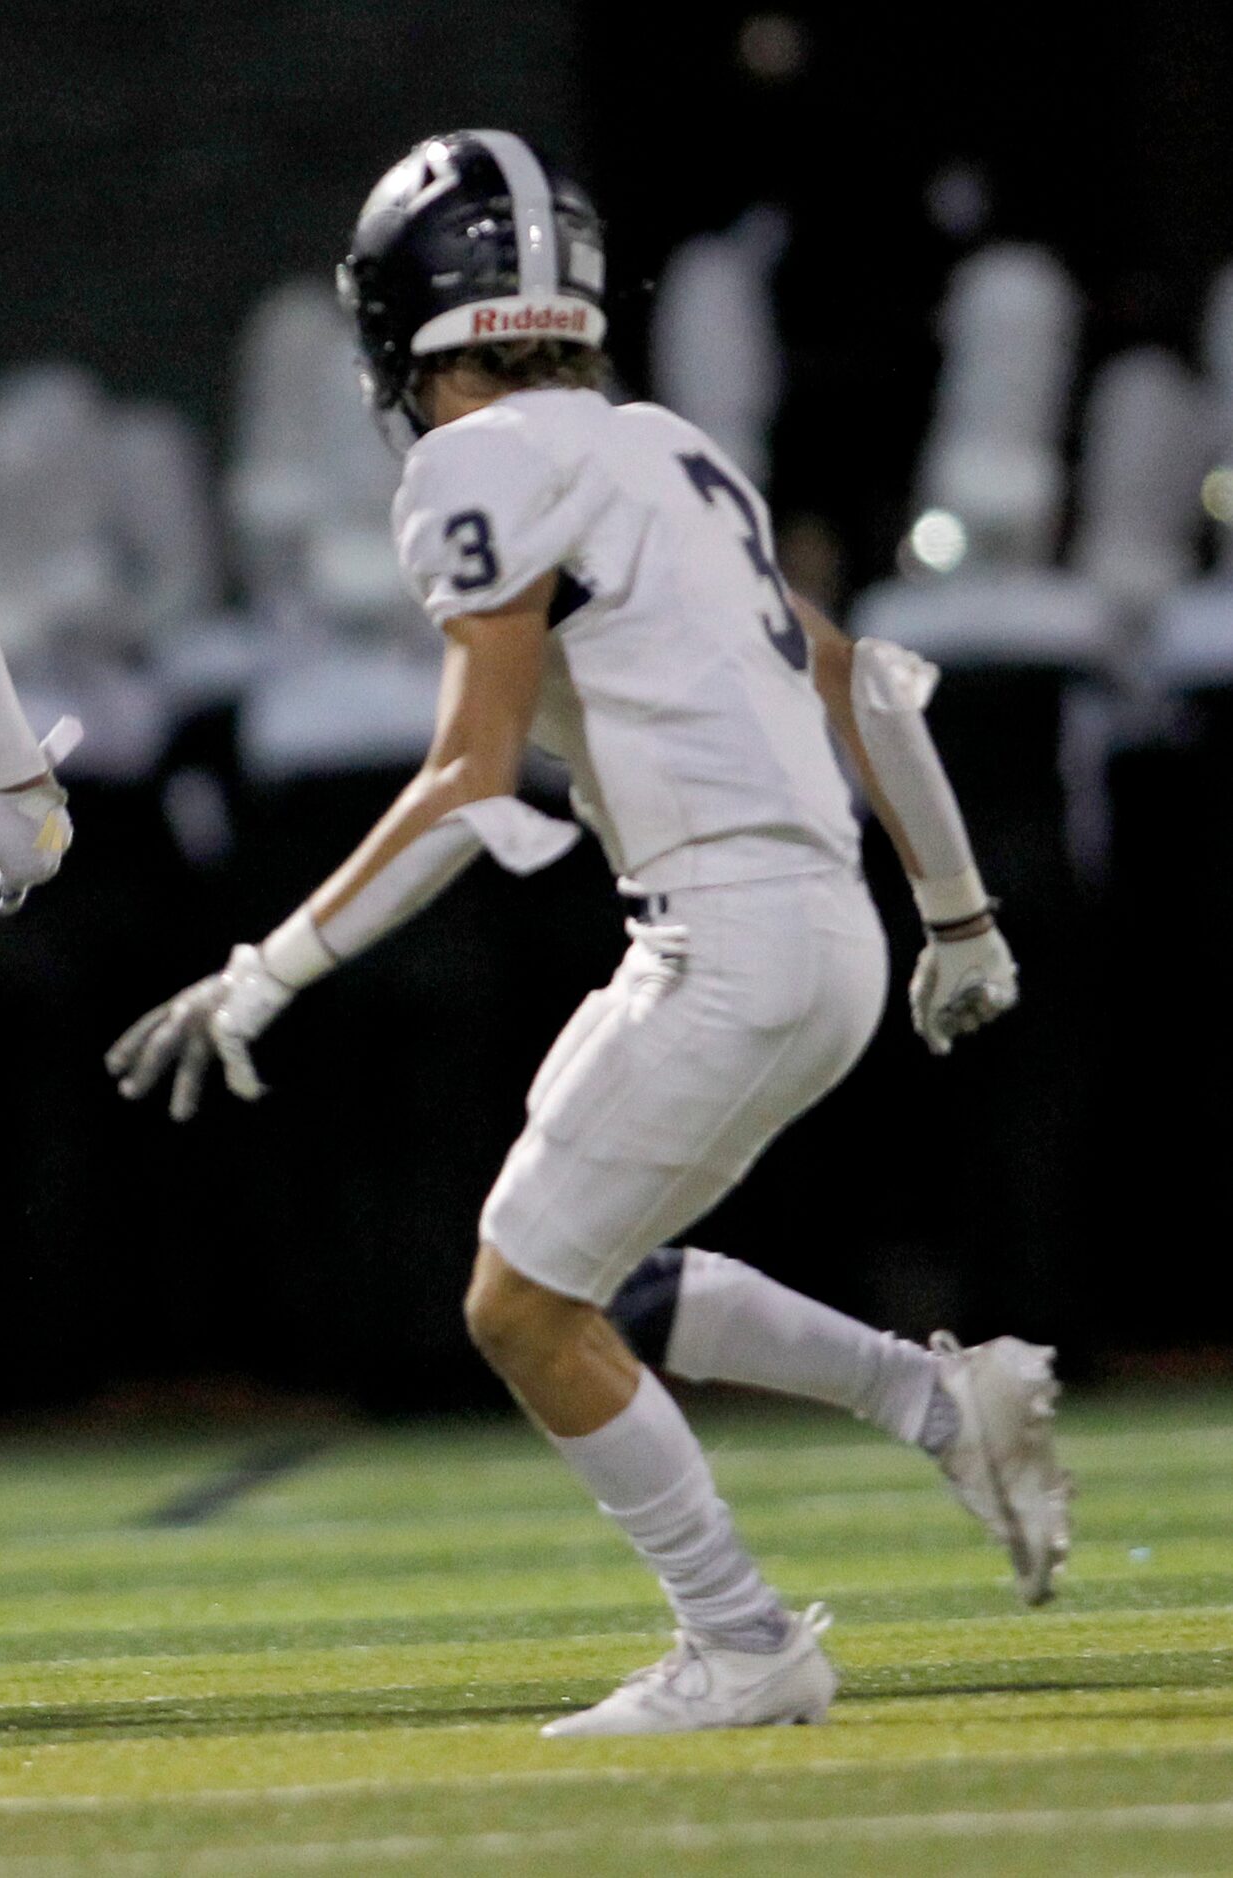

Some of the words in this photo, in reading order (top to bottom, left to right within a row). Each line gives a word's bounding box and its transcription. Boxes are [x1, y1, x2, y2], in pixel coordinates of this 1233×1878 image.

[471, 304, 588, 336] Riddell
[444, 508, 501, 592] 3
[677, 451, 809, 672] 3
